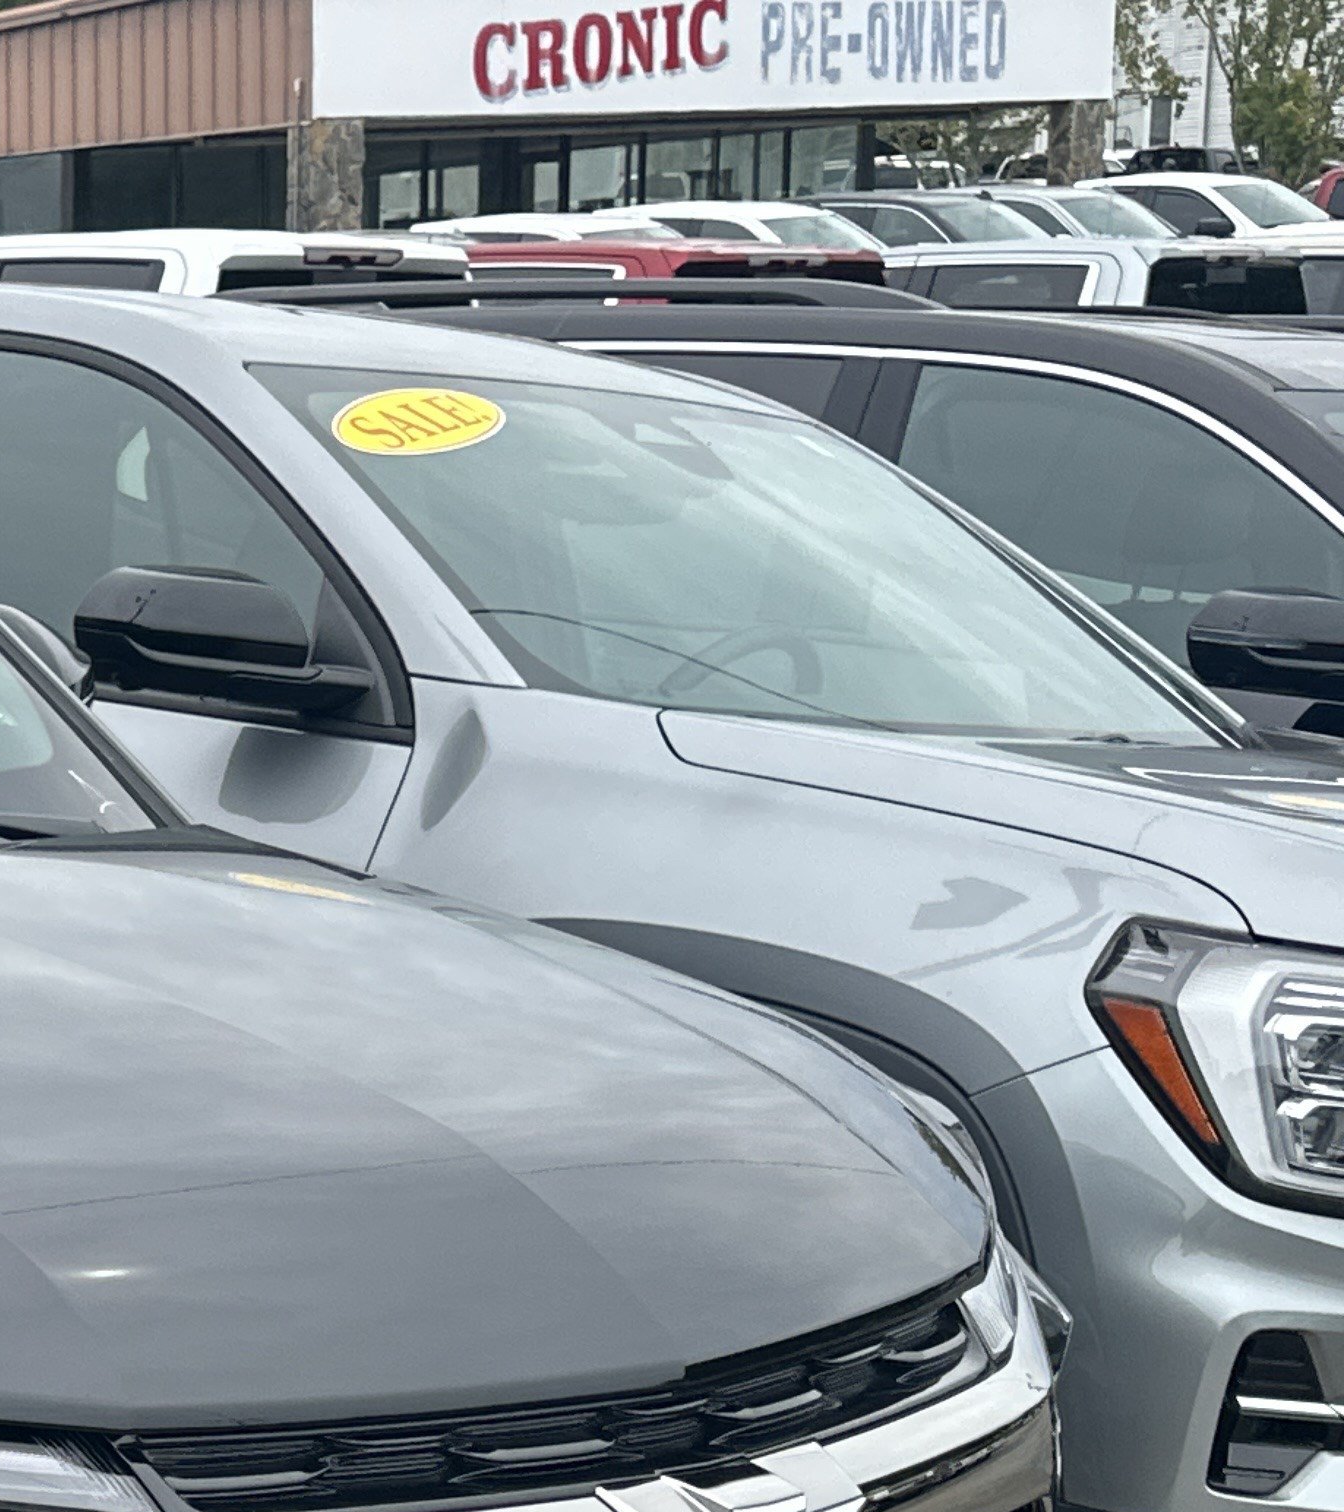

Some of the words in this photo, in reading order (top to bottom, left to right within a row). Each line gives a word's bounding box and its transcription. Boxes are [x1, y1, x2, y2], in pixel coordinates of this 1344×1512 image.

[473, 0, 729, 101] CRONIC
[760, 0, 1008, 84] PRE-OWNED
[349, 394, 492, 448] SALE!
